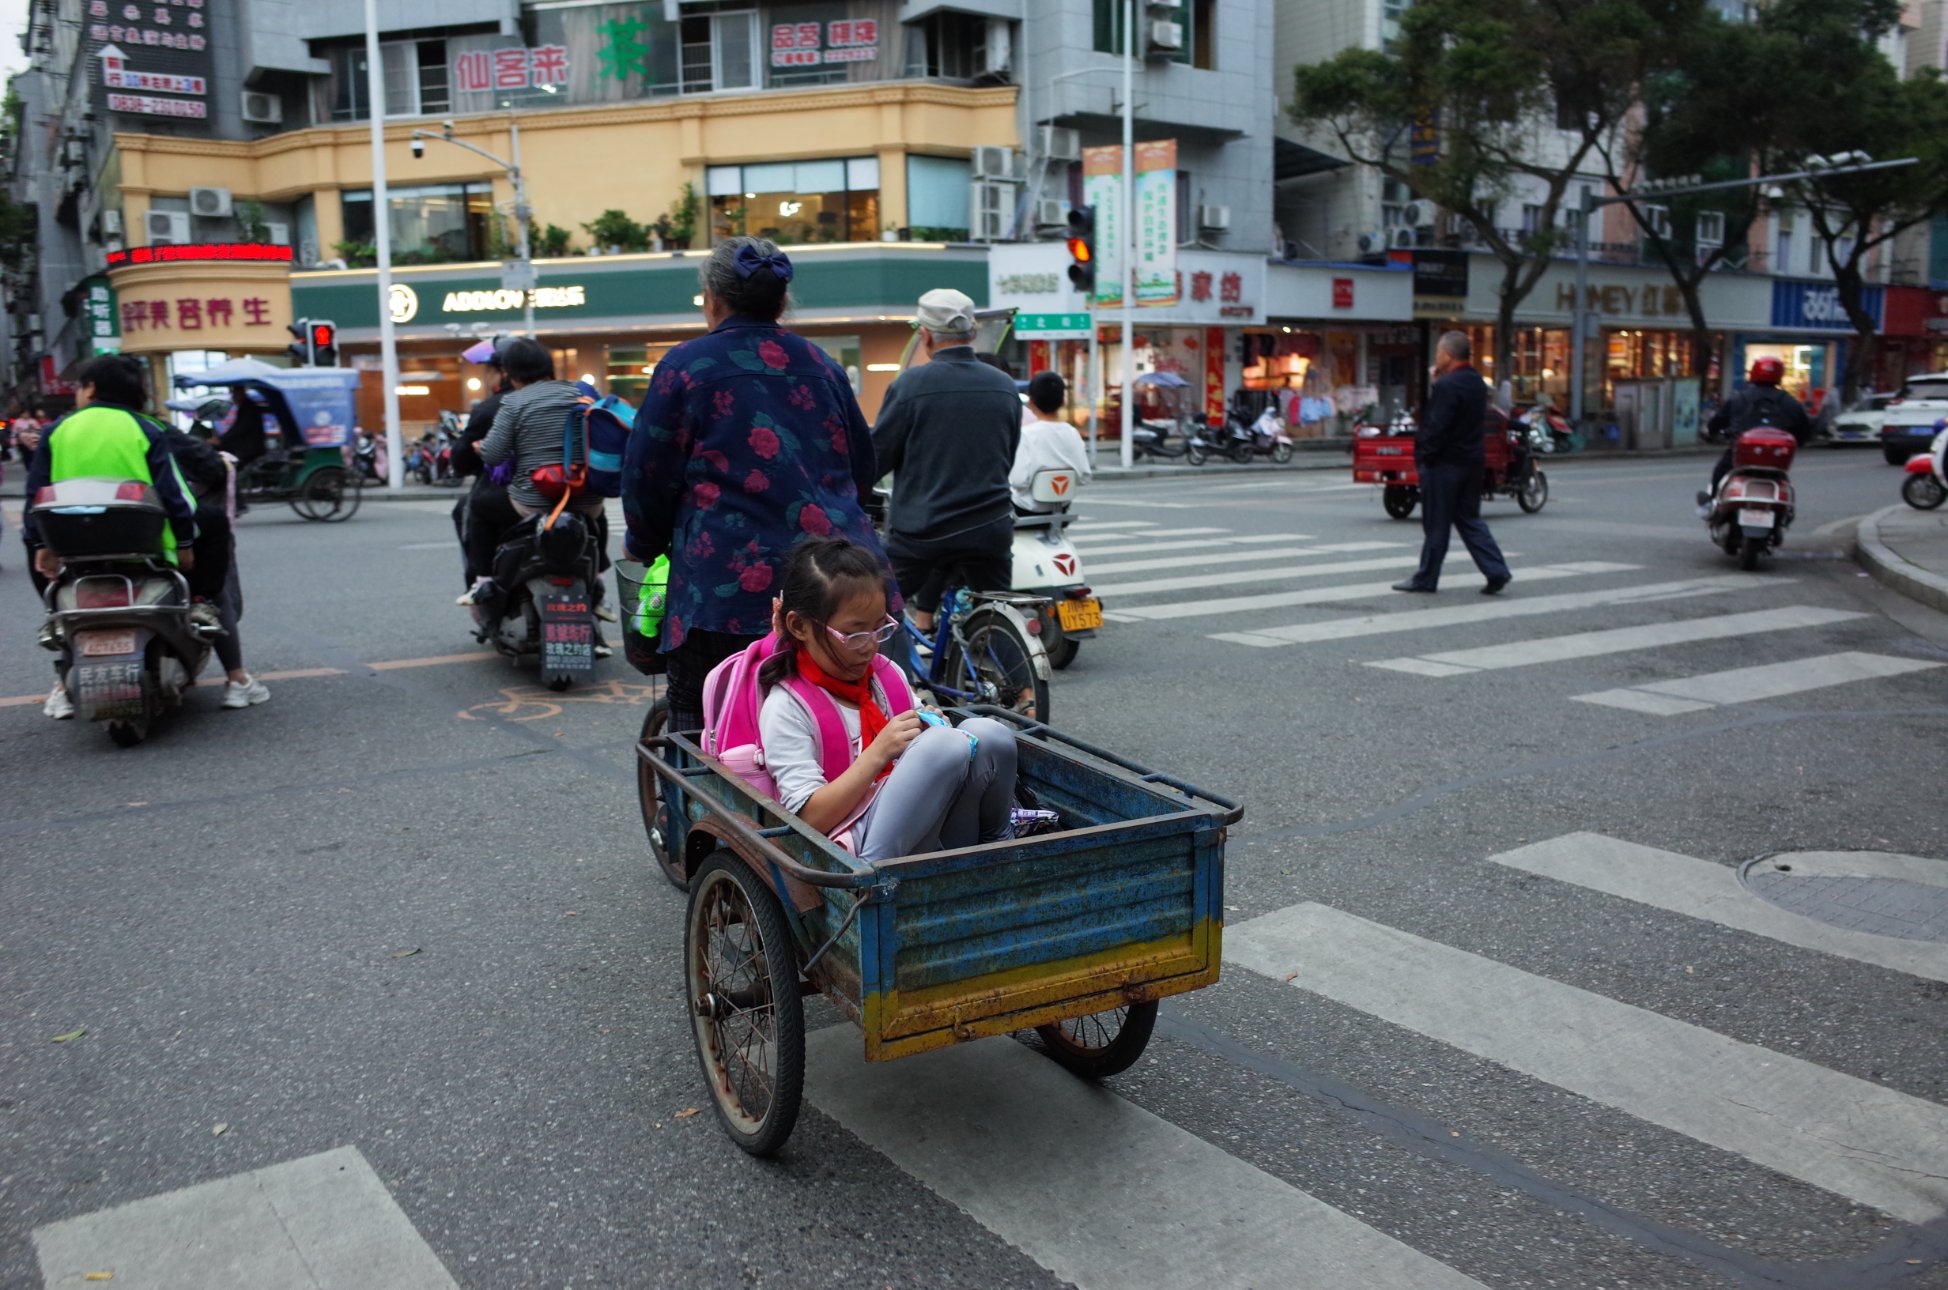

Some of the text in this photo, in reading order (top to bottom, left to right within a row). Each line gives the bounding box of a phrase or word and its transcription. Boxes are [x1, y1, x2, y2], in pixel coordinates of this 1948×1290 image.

[596, 15, 649, 81] 茶
[456, 45, 568, 91] 仙客来
[1556, 281, 1638, 315] HNEY
[1063, 611, 1101, 629] UY573
[79, 663, 141, 686] 民友车行
